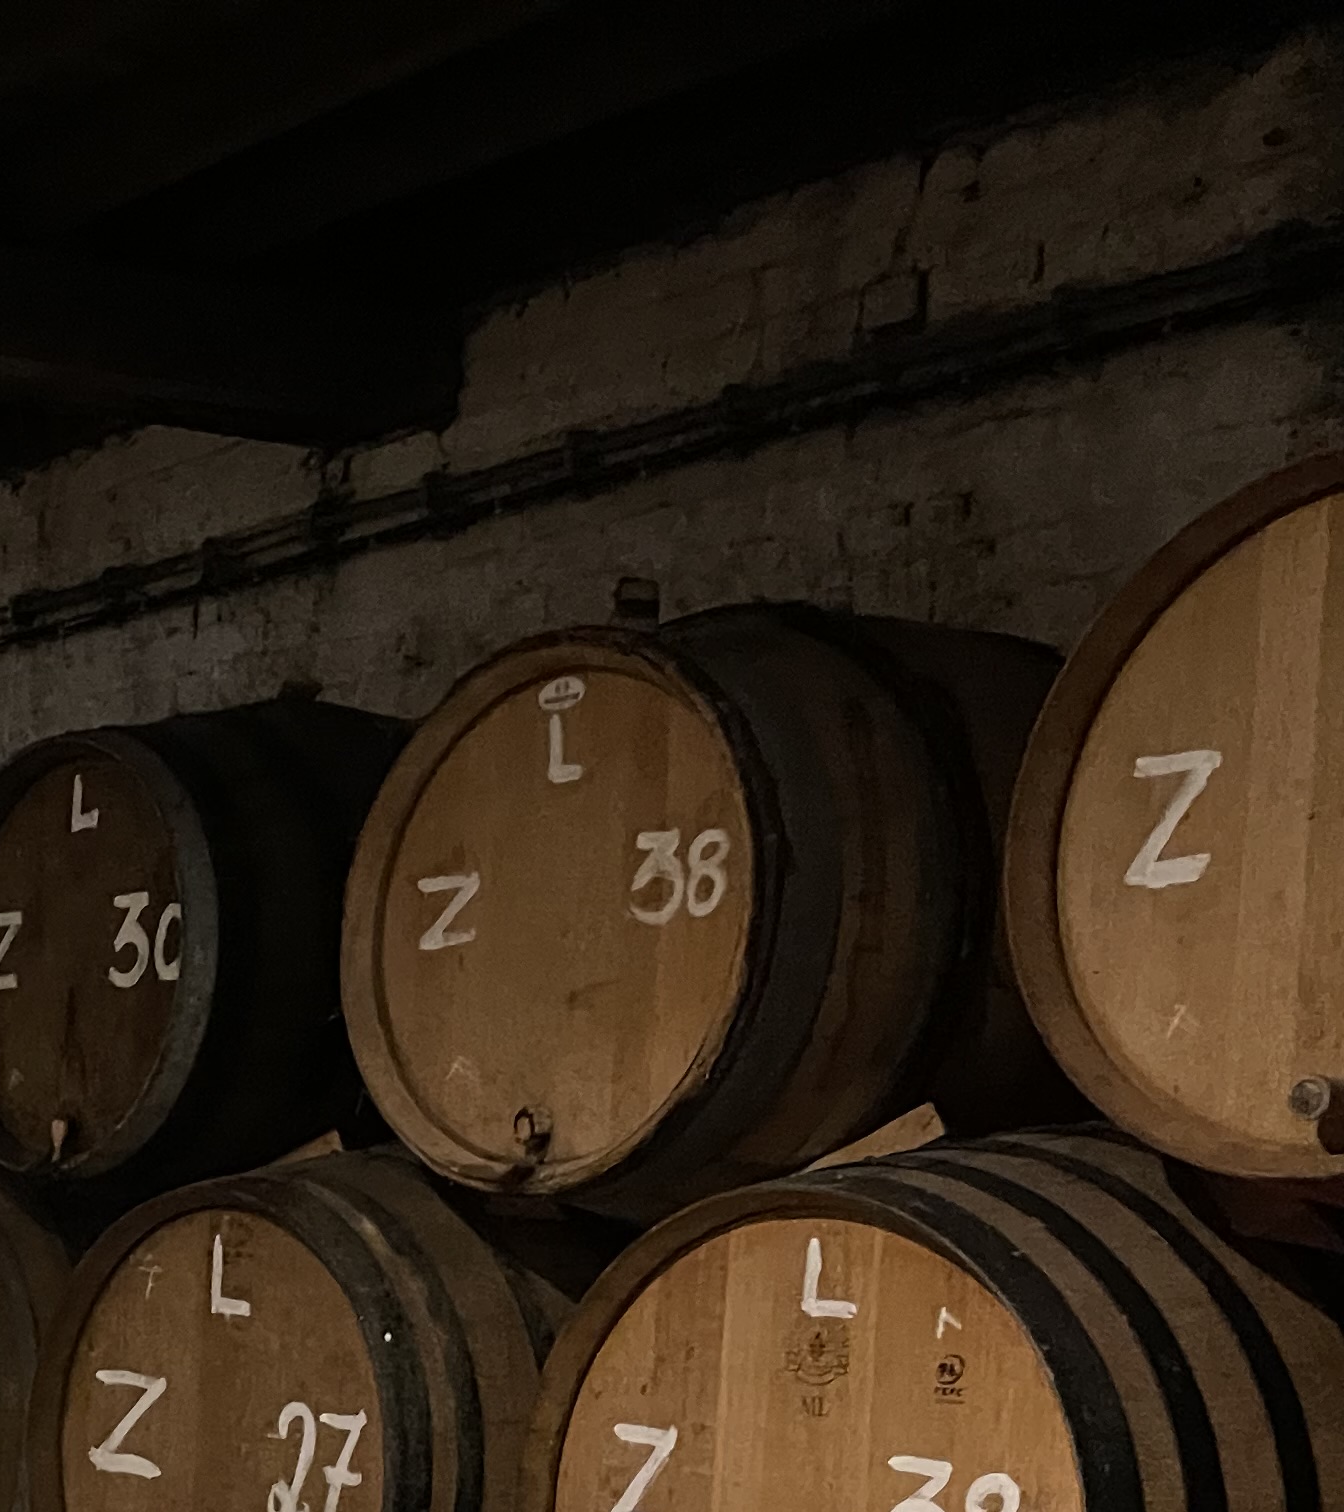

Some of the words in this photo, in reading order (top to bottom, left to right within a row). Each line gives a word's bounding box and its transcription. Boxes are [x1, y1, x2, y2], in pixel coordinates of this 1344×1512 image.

[548, 715, 583, 784] L
[71, 774, 99, 832] L
[1124, 750, 1222, 888] Z
[417, 871, 480, 951] Z
[628, 828, 730, 925] 38
[211, 1233, 251, 1317] L
[801, 1238, 858, 1319] L
[88, 1369, 167, 1480] Z
